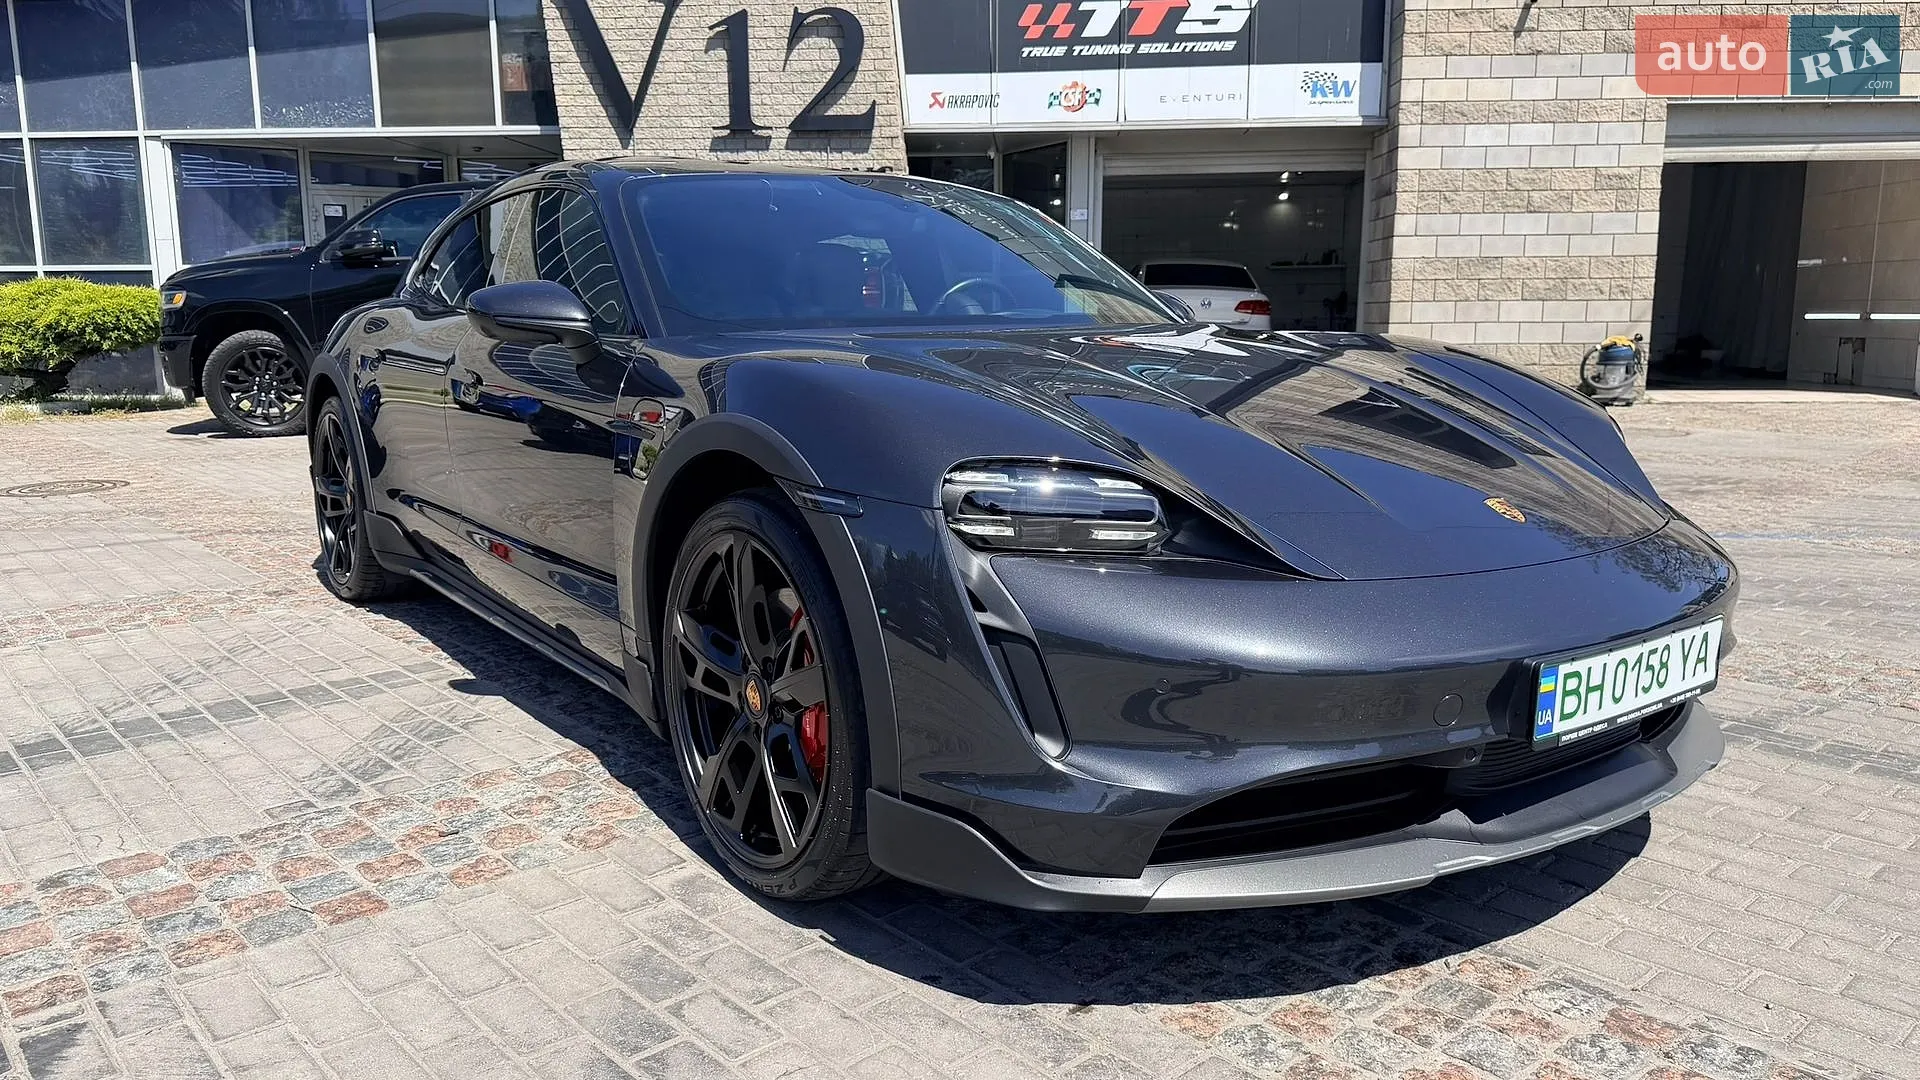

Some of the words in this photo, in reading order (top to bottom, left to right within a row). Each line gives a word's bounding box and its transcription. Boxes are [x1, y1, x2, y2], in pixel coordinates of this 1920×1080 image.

[1078, 0, 1258, 38] TTS
[1021, 46, 1067, 58] TRUE
[1072, 43, 1135, 56] TUNING
[1137, 40, 1237, 54] SOLUTIONS
[551, 0, 876, 132] V12
[1310, 80, 1357, 98] KW
[1559, 662, 1608, 722] BH
[1611, 643, 1671, 705] 0158
[1681, 631, 1709, 682] YA
[1537, 708, 1553, 726] UA
